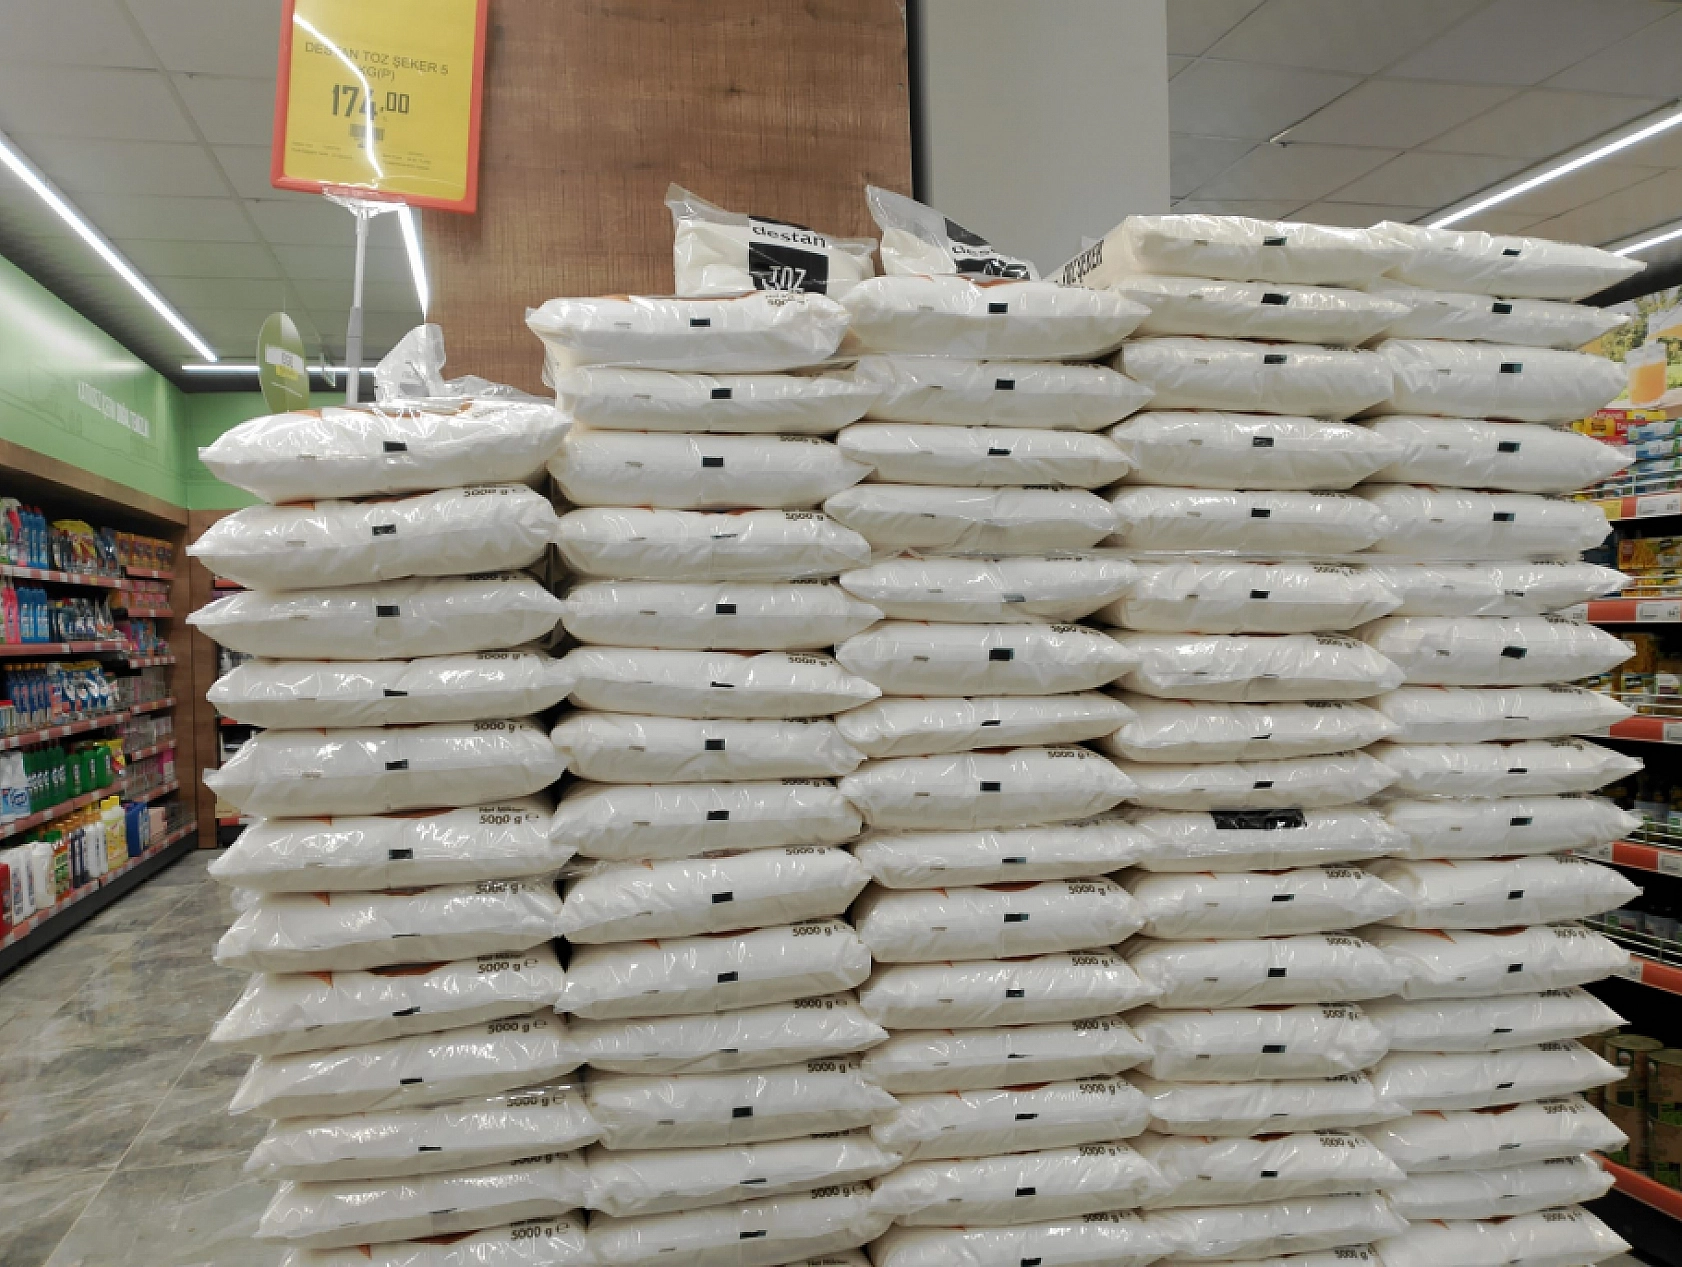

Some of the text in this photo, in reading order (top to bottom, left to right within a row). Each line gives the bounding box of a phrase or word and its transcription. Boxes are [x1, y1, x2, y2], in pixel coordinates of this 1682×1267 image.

[305, 42, 449, 76] DESAN TOZ ŞEKER 5
[752, 226, 826, 248] destan
[477, 962, 510, 973] 5000
[488, 1022, 518, 1034] 5000
[511, 1226, 541, 1240] 5000
